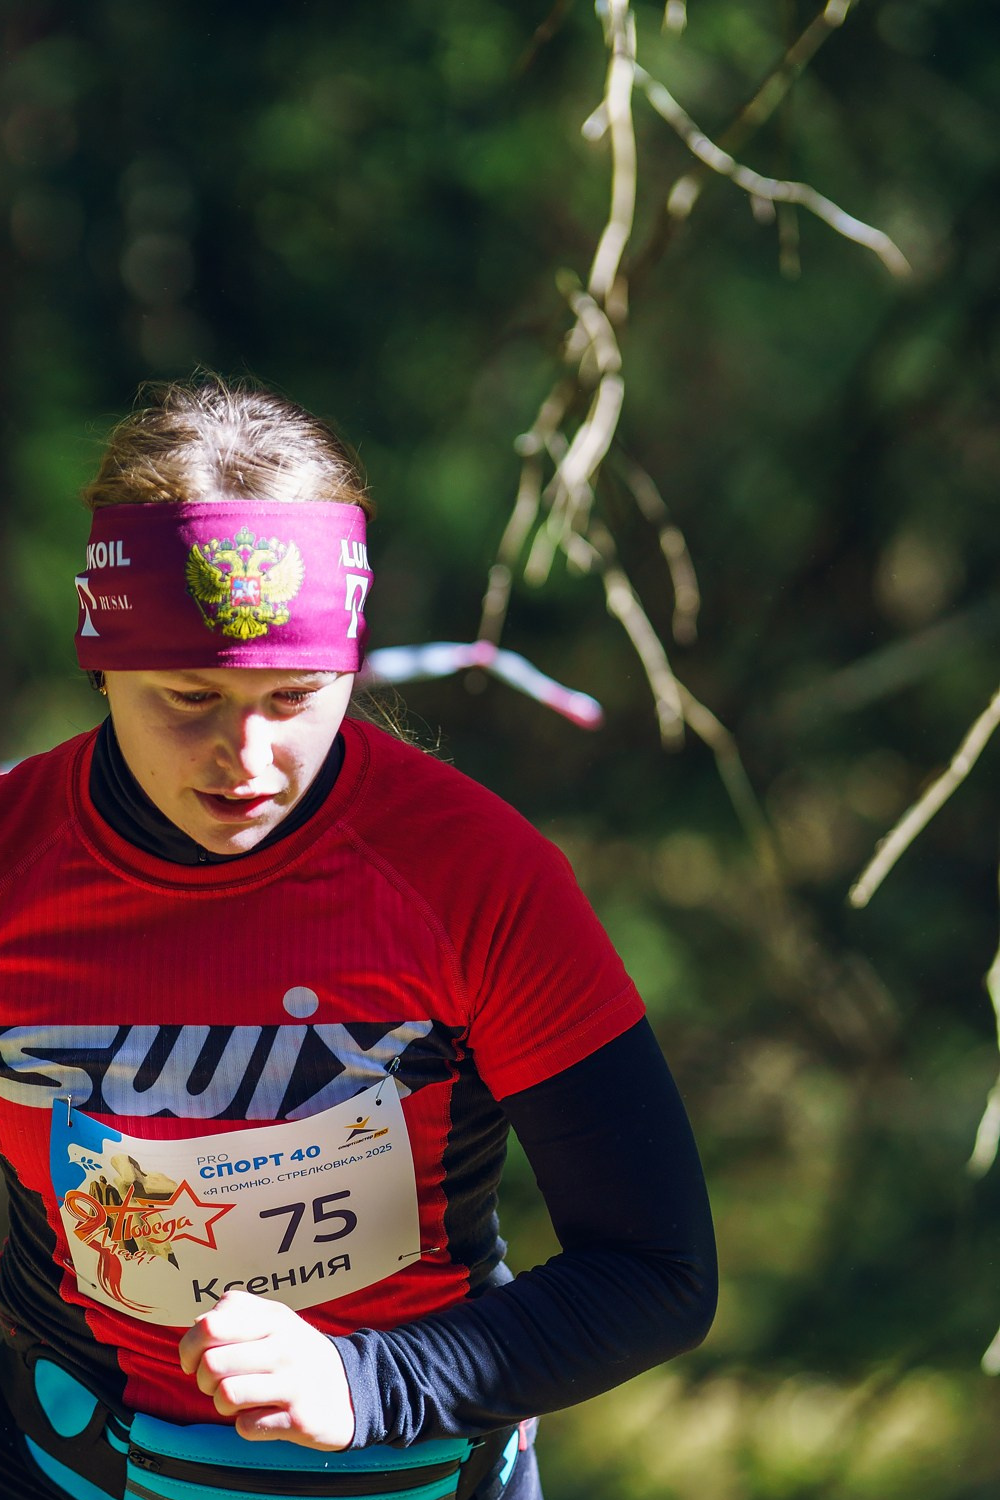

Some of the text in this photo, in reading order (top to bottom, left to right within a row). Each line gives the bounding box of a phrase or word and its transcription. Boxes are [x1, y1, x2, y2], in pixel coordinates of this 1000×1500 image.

[86, 540, 131, 571] KOIL
[99, 594, 133, 610] RUSAL
[196, 1153, 229, 1166] PRO
[199, 1145, 321, 1179] СПОРТ 40
[203, 1142, 393, 1196] «Я ПОМНЮ. СТРЕЛКОВКА» 2025
[259, 1189, 358, 1254] 75
